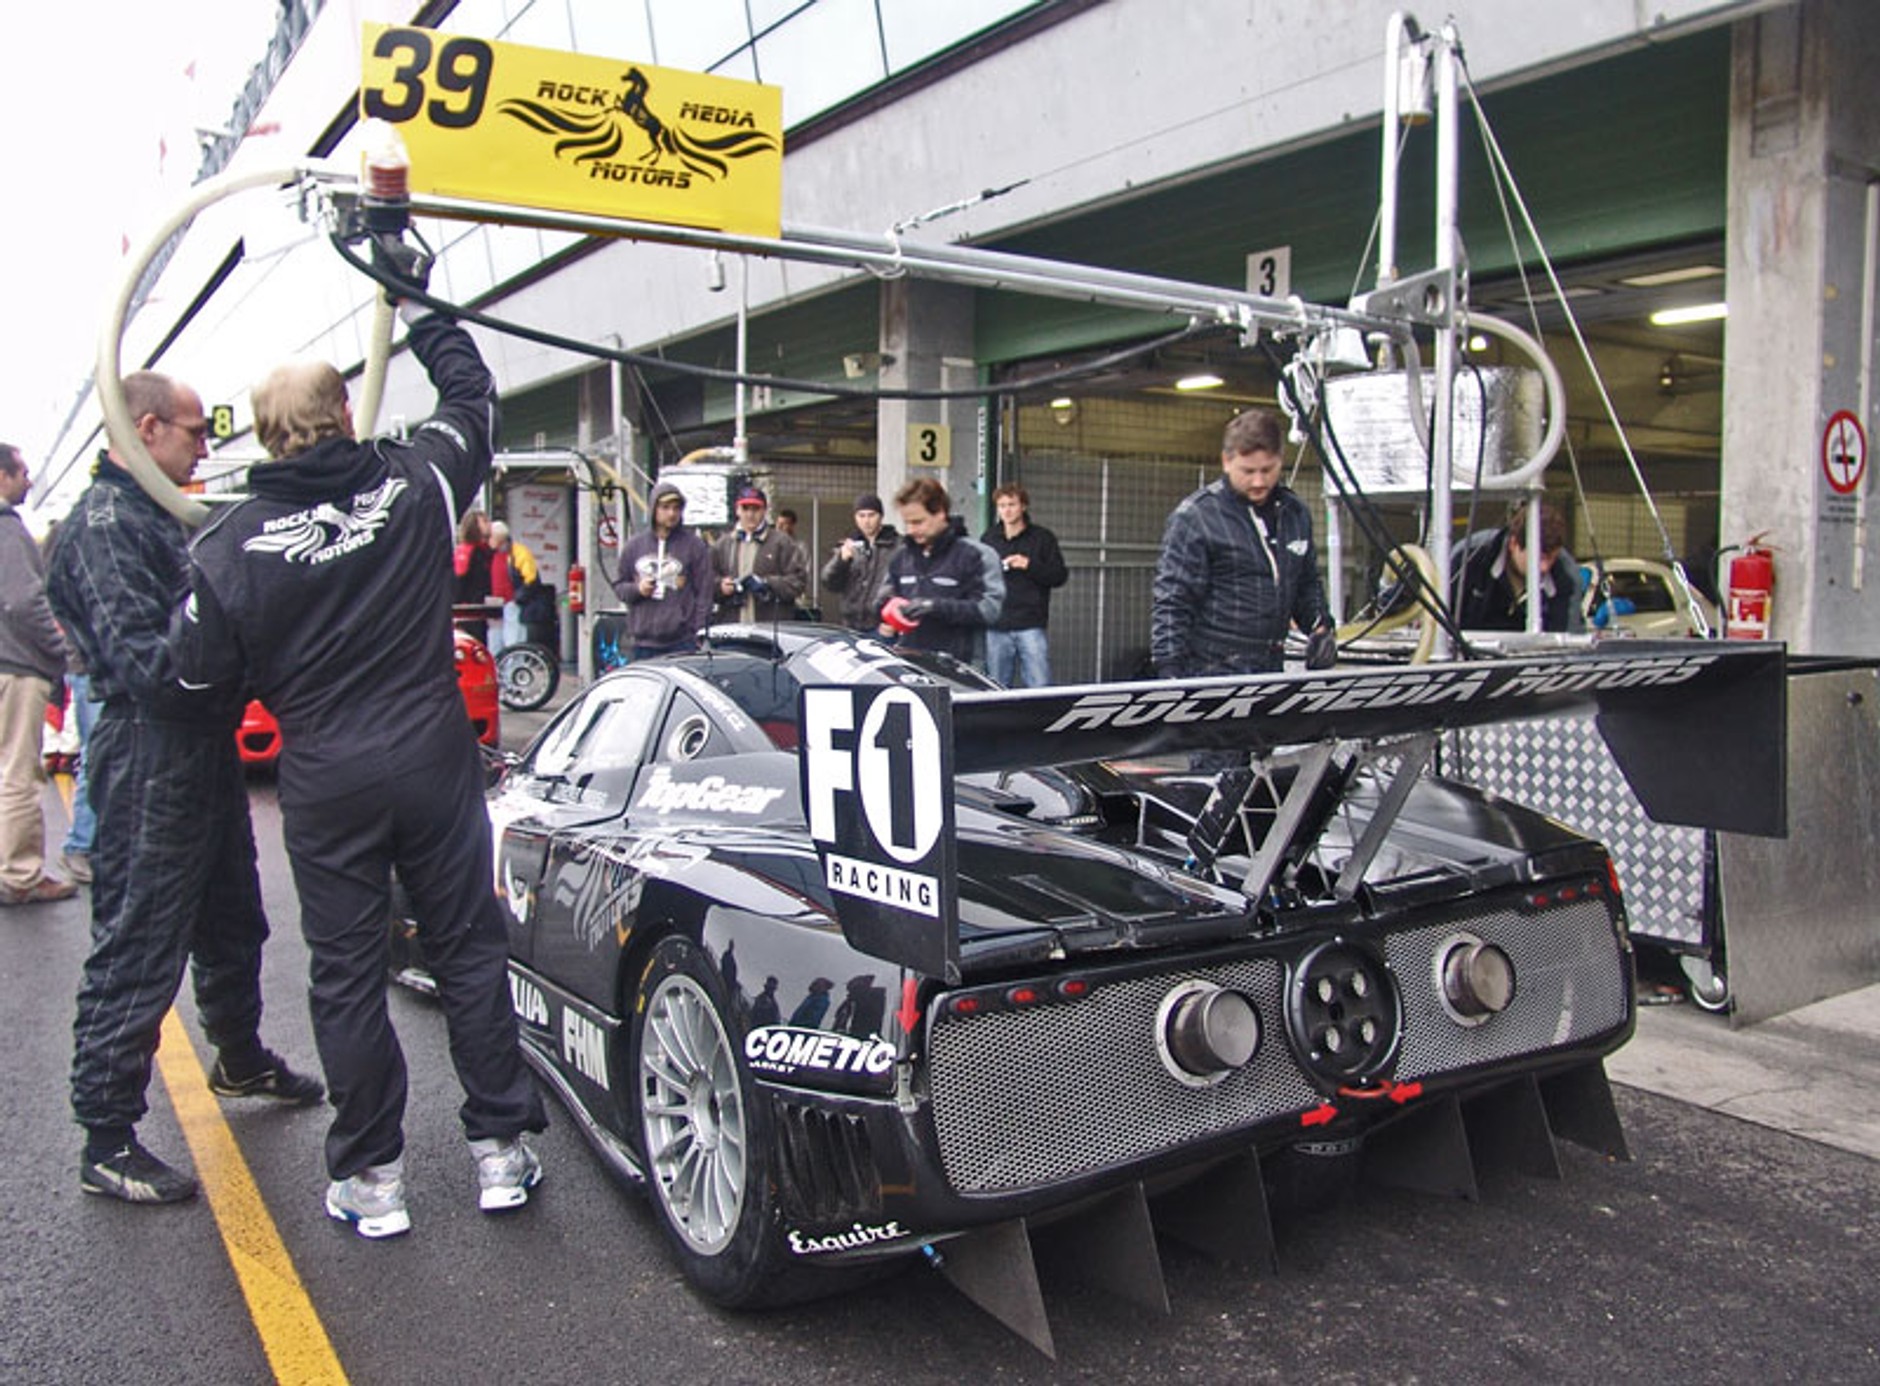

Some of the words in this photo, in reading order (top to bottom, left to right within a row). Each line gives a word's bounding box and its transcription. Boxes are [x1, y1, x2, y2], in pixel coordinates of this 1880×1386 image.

[364, 28, 494, 128] 39
[537, 80, 610, 107] ROCK
[590, 161, 692, 189] MOTORS
[1260, 257, 1276, 296] 3
[214, 408, 232, 437] 8
[921, 429, 936, 462] 3
[263, 509, 309, 533] ROCK
[310, 529, 375, 565] MOTORS
[1045, 683, 1290, 732] ROCK
[1267, 670, 1492, 716] MEDIA
[1486, 656, 1720, 699] MOTORS
[805, 688, 930, 853] F1
[832, 861, 932, 906] RACING
[745, 1028, 896, 1074] COMETIC
[787, 1221, 911, 1253] Esquire
